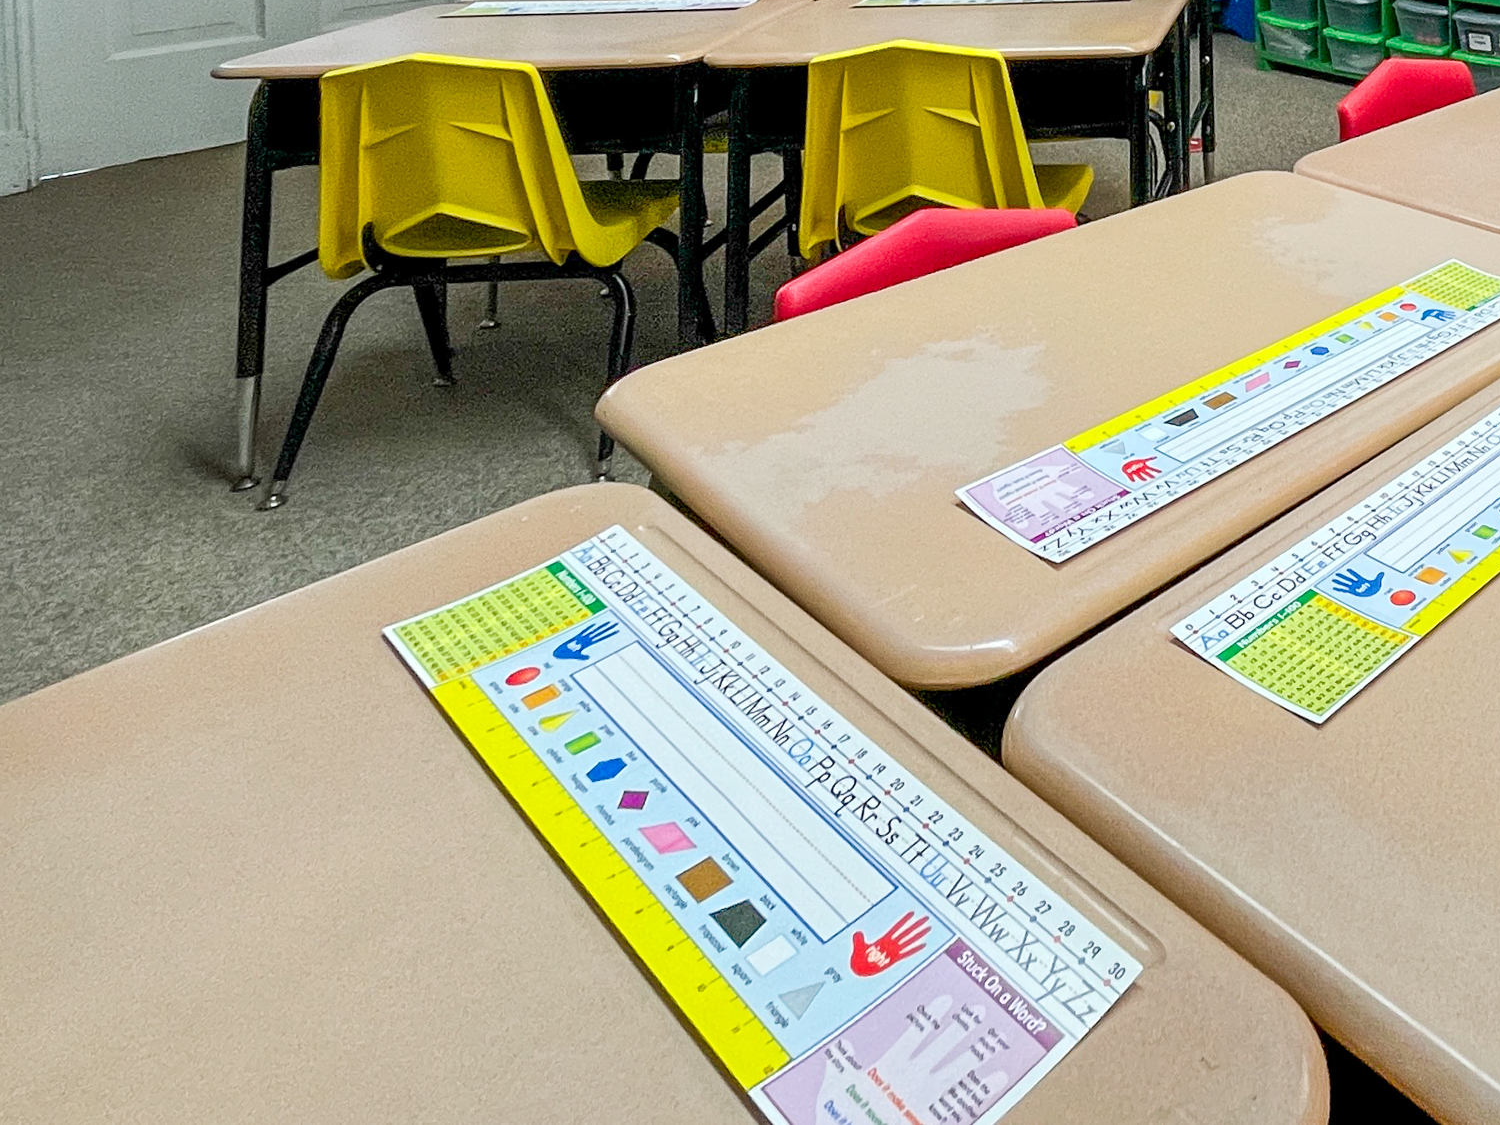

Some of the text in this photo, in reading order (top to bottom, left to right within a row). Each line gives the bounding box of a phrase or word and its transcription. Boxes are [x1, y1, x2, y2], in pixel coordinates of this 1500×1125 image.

[1224, 572, 1307, 630] Bb Cc Dd
[1236, 614, 1280, 649] Numbers
[989, 862, 1126, 980] 25 28 29 30
[865, 946, 891, 967] right
[957, 950, 1047, 1034] Stuck On a Word?
